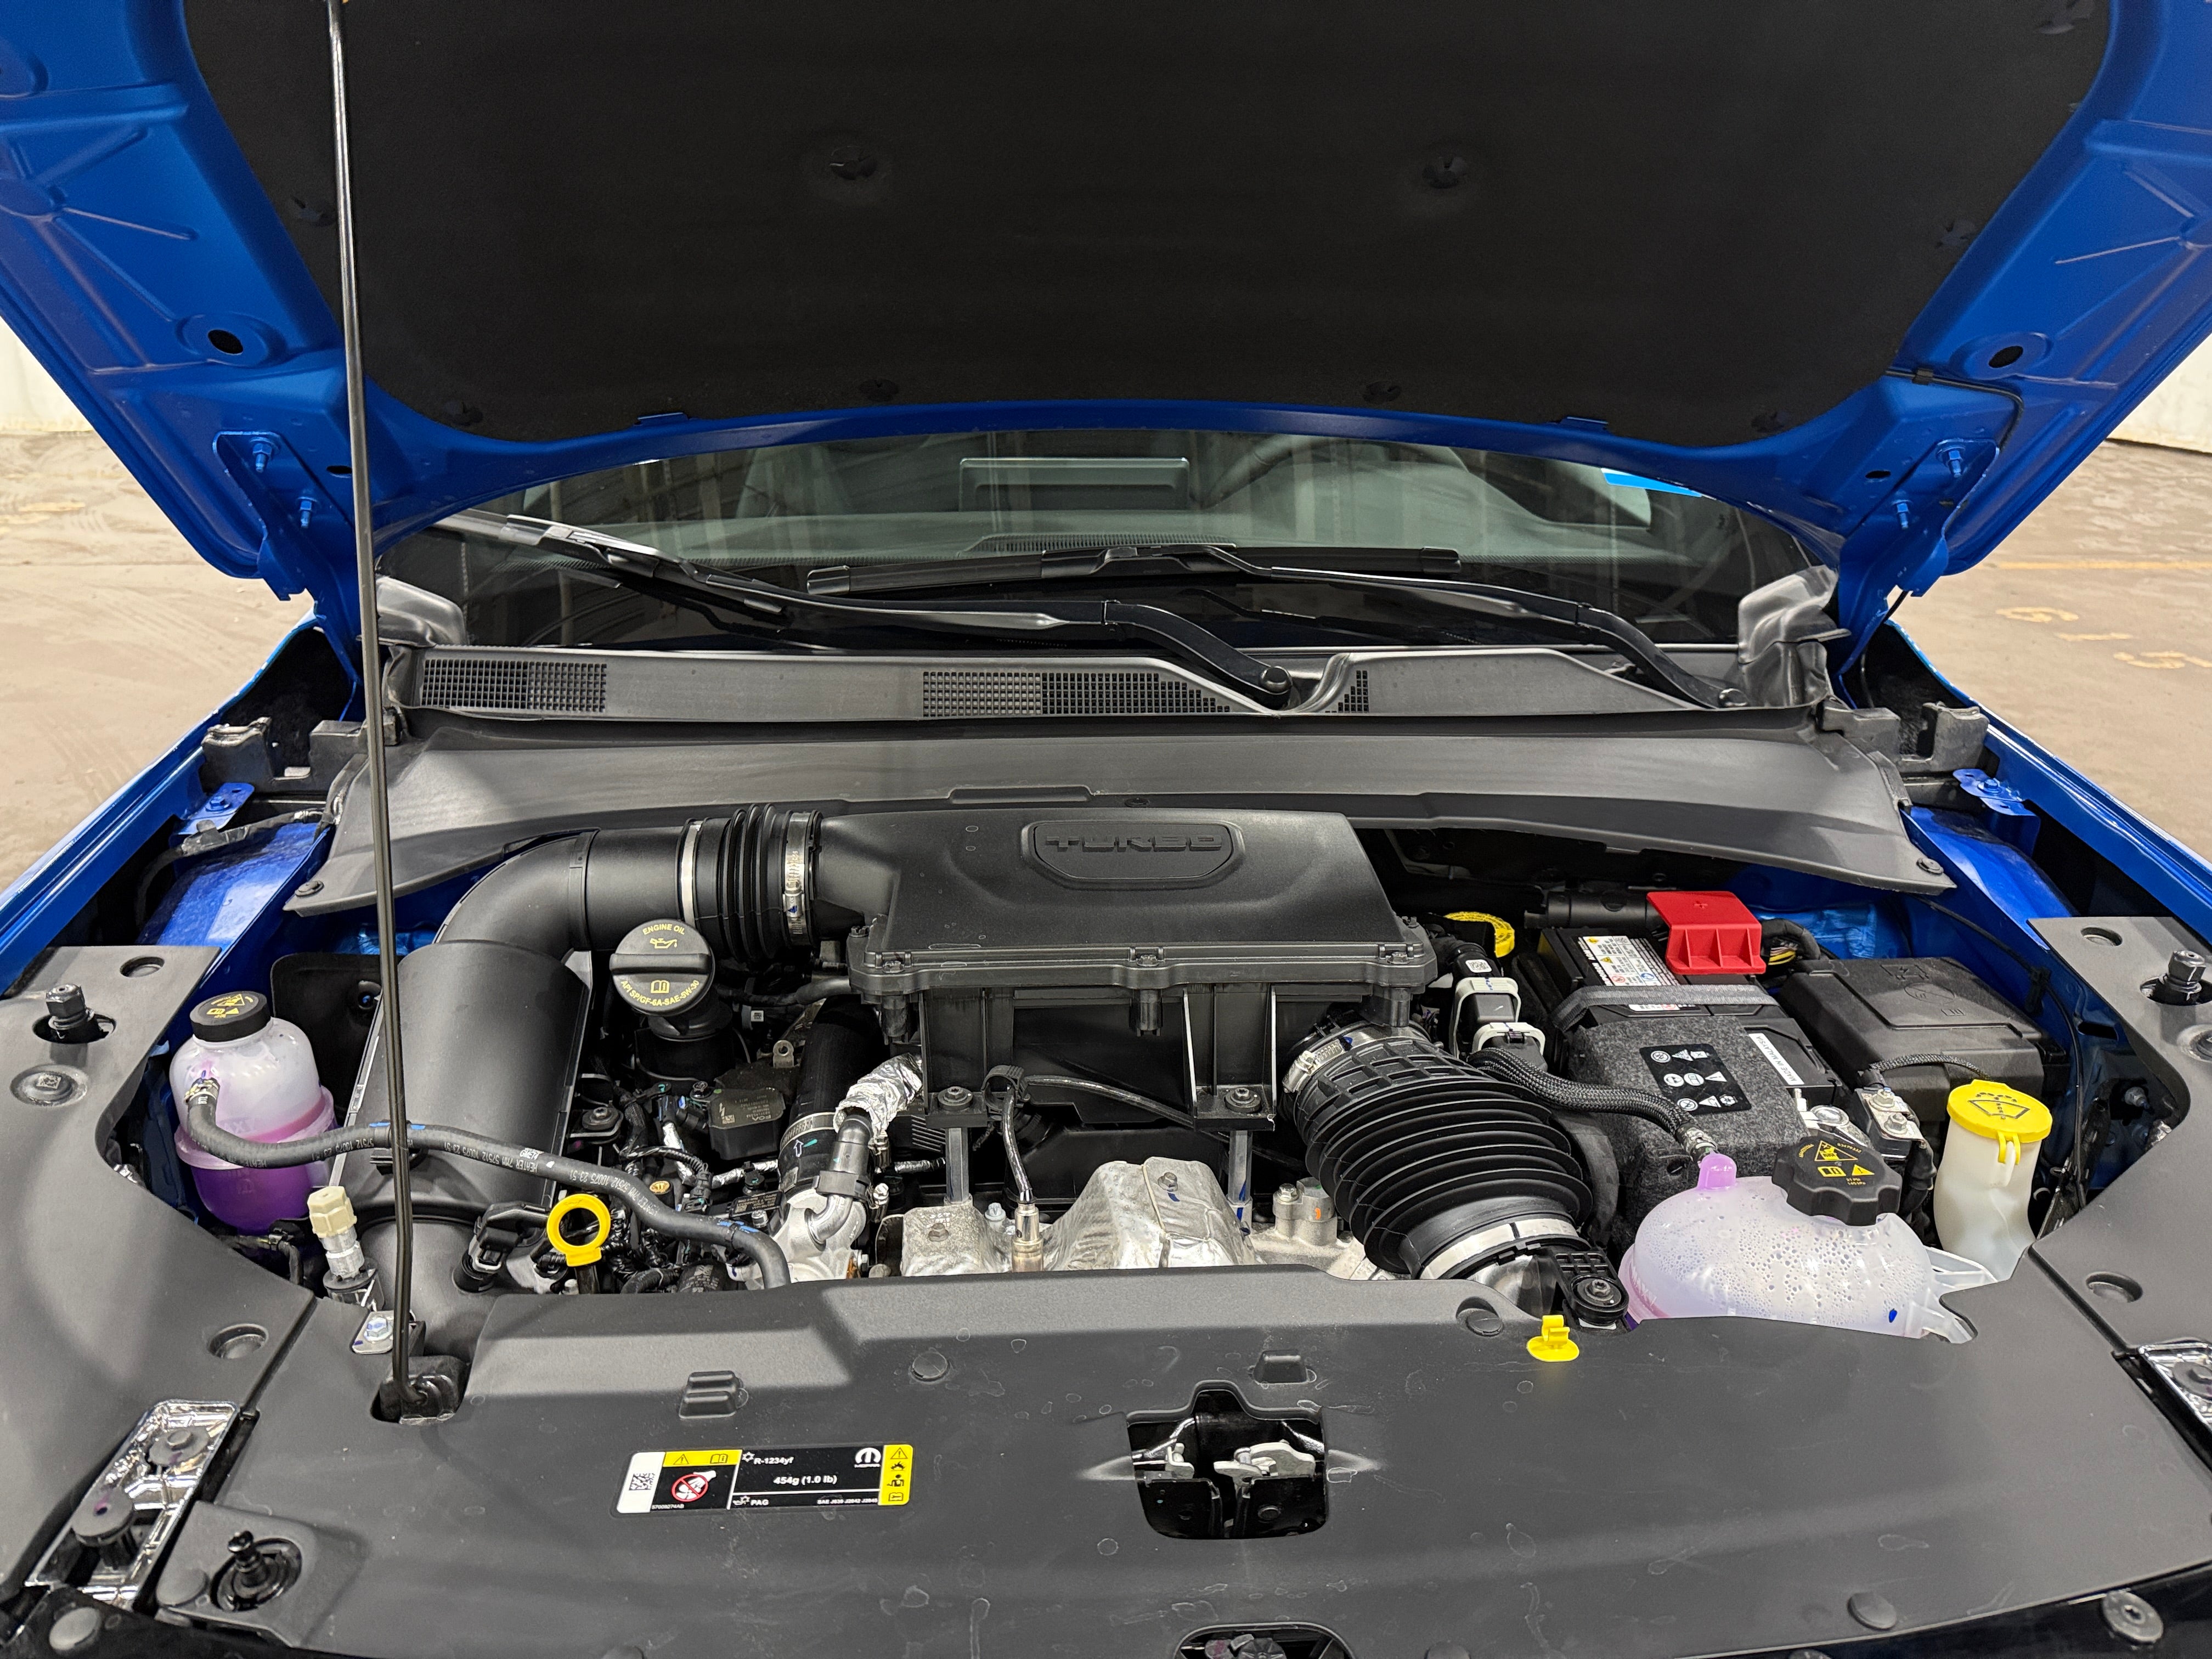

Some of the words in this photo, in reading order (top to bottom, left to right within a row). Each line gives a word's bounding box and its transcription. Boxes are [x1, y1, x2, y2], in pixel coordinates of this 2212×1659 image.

[1046, 836, 1222, 852] TURBO
[642, 923, 673, 935] ENGINE
[674, 925, 685, 935] OIL
[621, 980, 630, 992] API
[1756, 1036, 1779, 1059] MALAYSIA
[1781, 1067, 1797, 1081] MADE
[482, 1151, 500, 1164] 57512
[516, 1159, 538, 1173] HEATER
[590, 1172, 610, 1186] 10075
[611, 1177, 631, 1193] 57512
[754, 1457, 794, 1465] R-1234yf
[773, 1476, 799, 1485] 454g
[802, 1475, 821, 1485] (1.0
[823, 1475, 837, 1485] lb)
